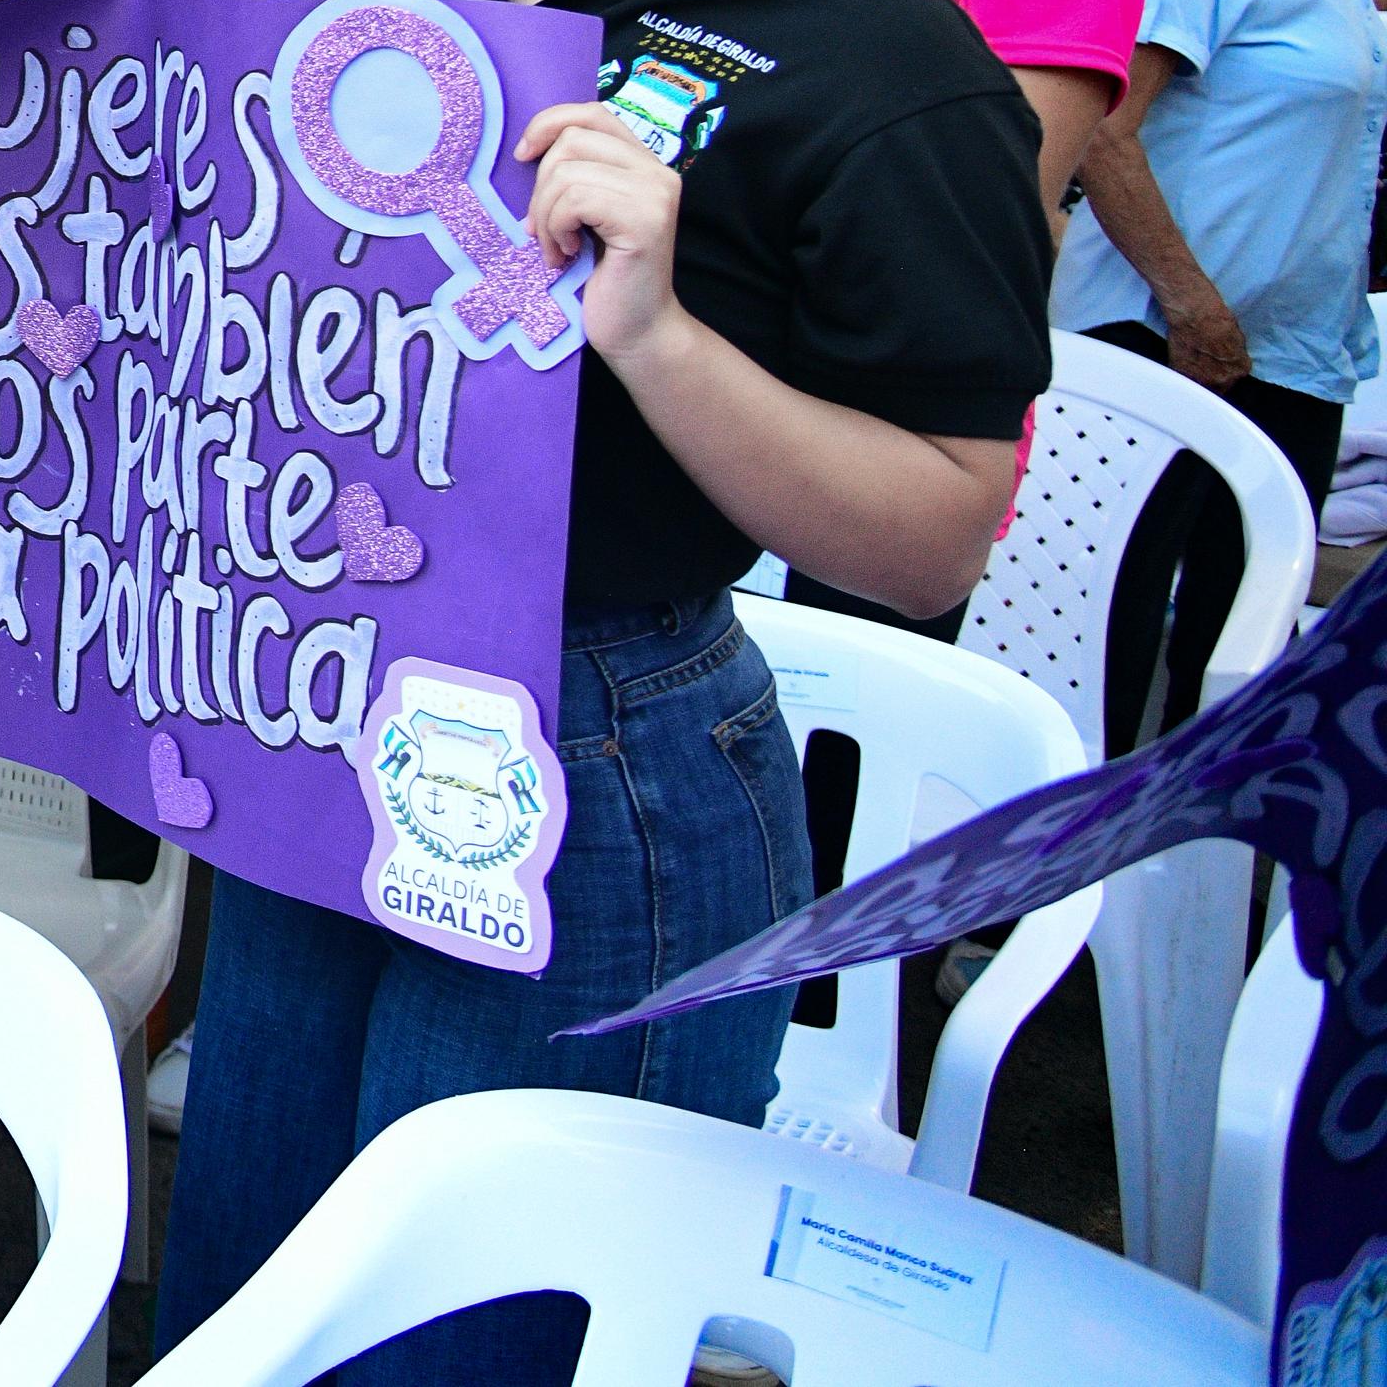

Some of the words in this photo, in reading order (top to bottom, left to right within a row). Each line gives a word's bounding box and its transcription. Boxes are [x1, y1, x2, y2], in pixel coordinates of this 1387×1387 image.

[637, 10, 704, 44] ALCALDÍA
[698, 32, 722, 49] DE
[716, 38, 777, 73] GIRALDO
[111, 350, 345, 593] parte
[382, 884, 525, 948] GIRALDO
[384, 860, 490, 908] ALCALDÍA
[497, 893, 525, 919] DE
[838, 1229, 883, 1252] Camila
[882, 1259, 900, 1273] de
